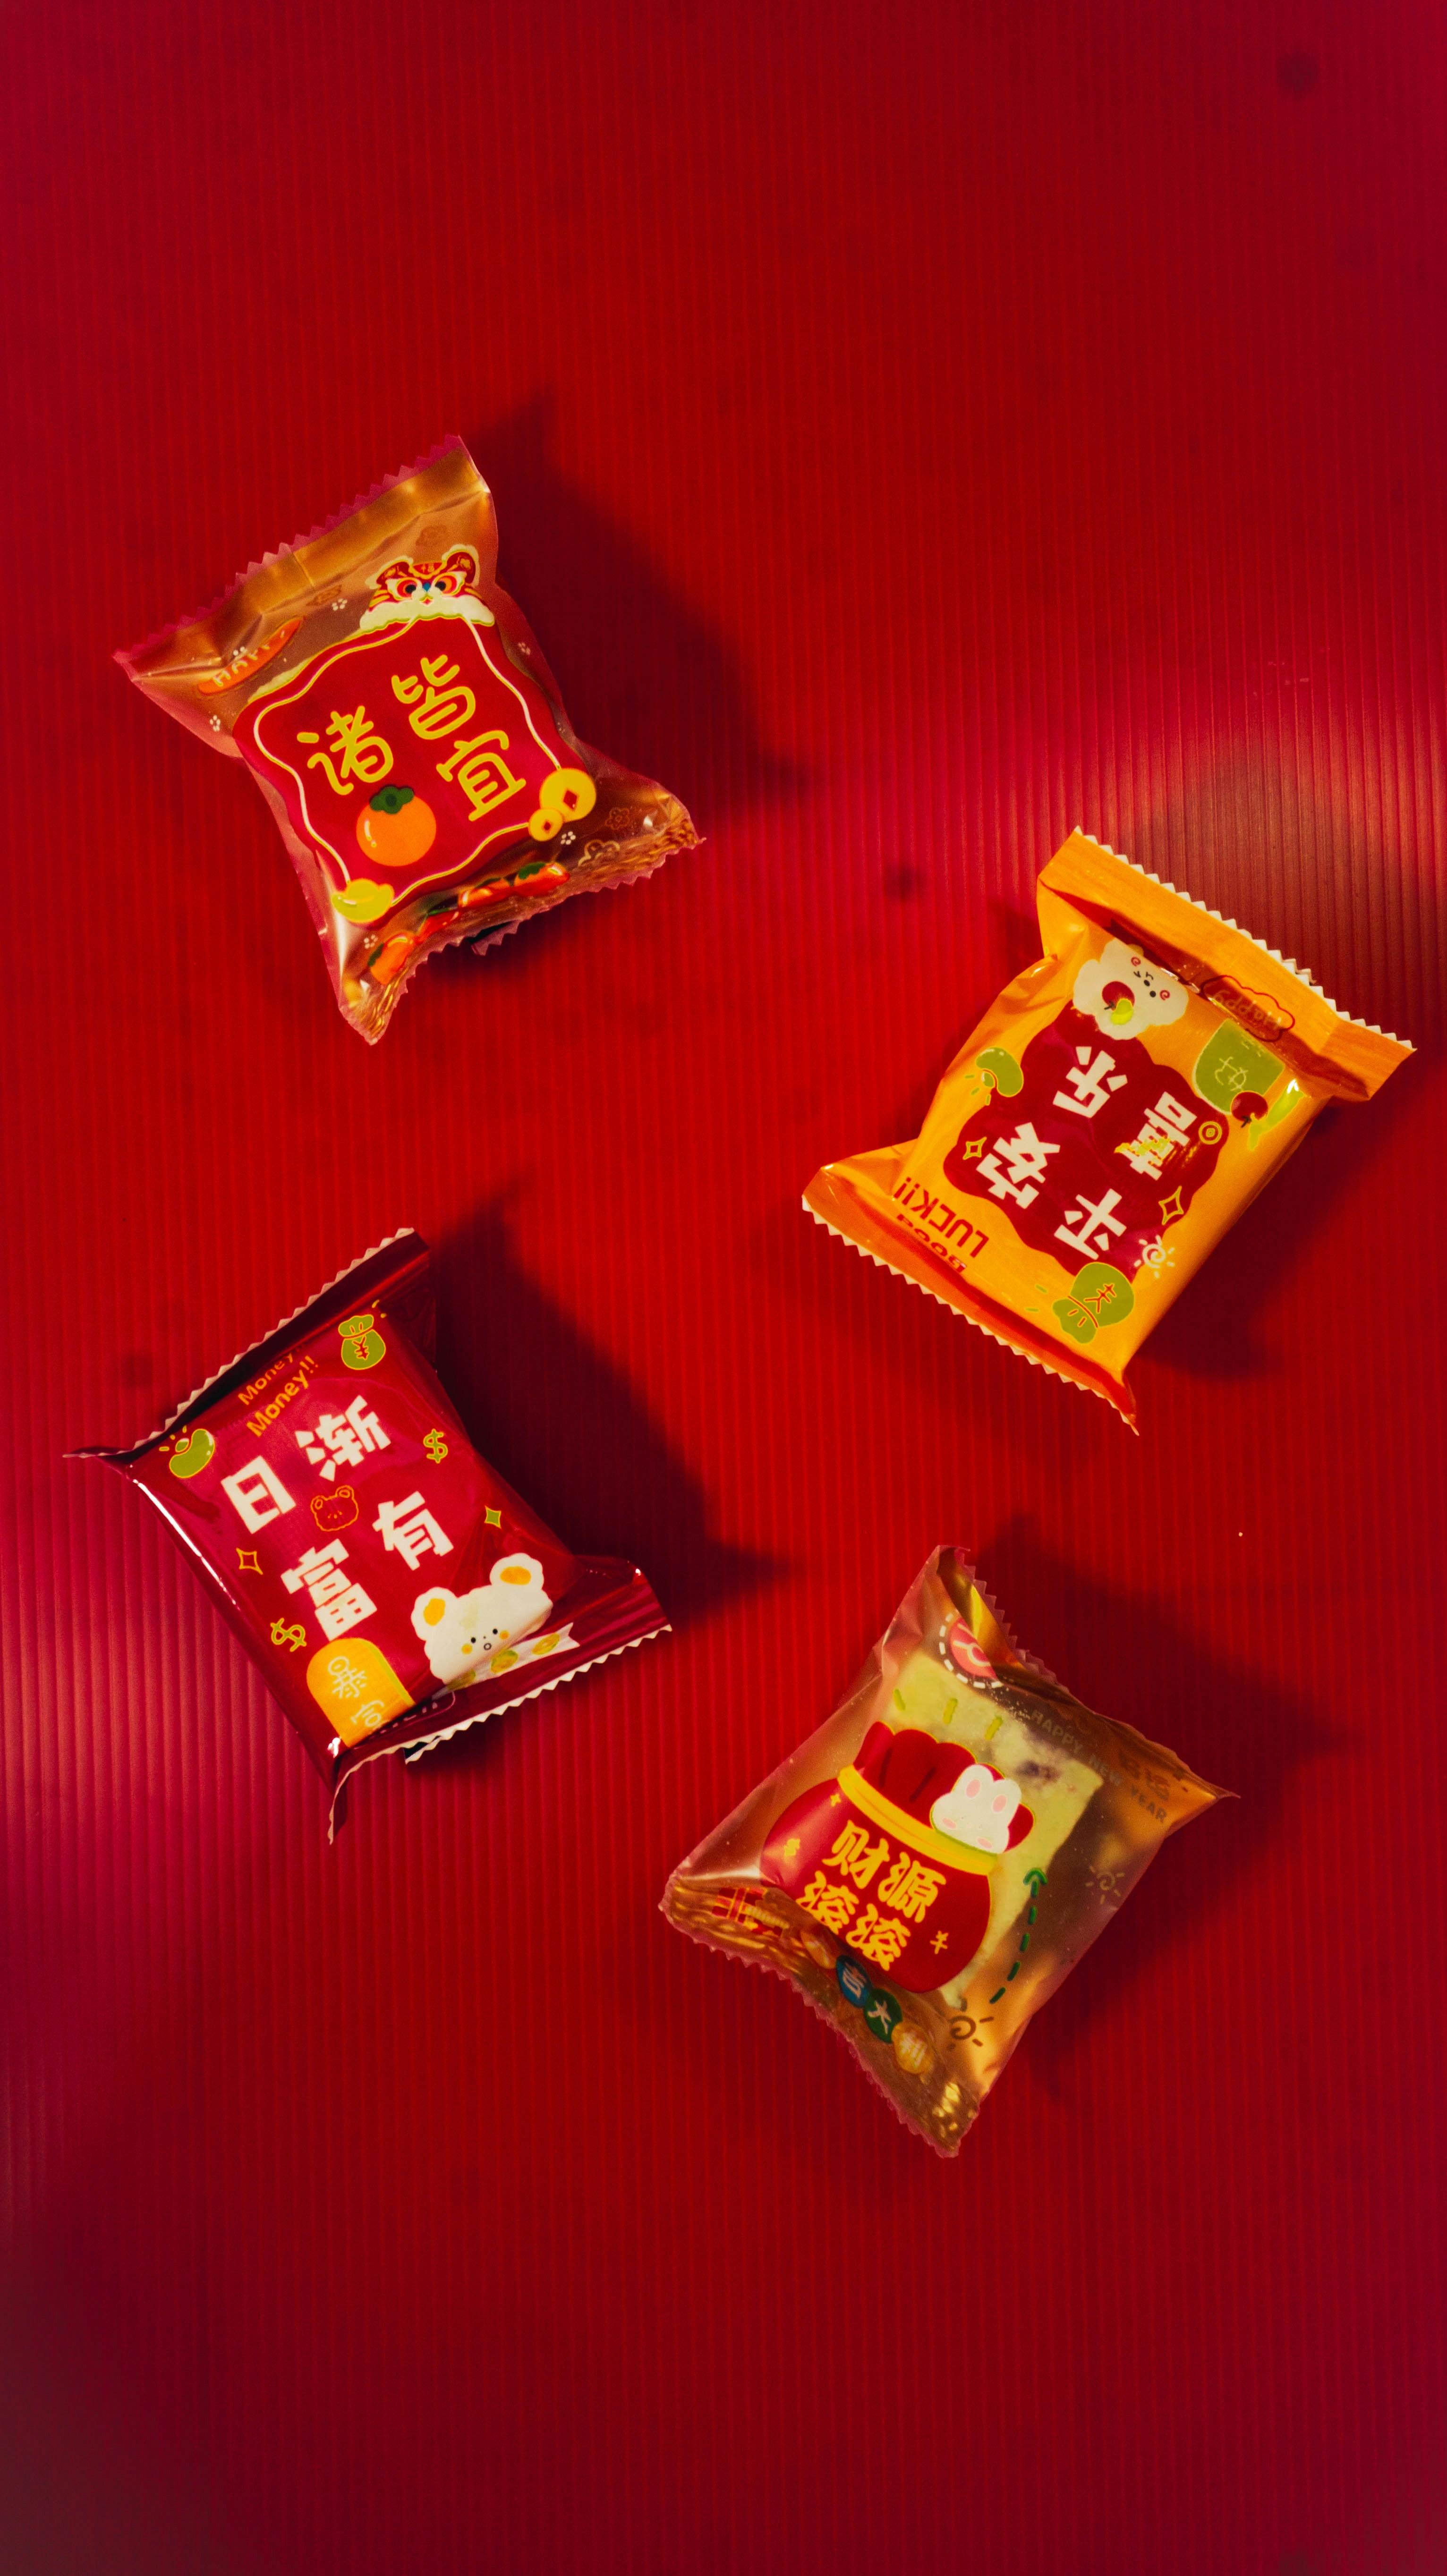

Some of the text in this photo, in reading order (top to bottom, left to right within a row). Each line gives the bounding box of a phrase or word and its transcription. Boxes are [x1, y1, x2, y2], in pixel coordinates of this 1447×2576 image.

[893, 1176, 990, 1259] LUCK!!
[247, 1355, 319, 1438] Money!!
[822, 1819, 946, 1923] 财源
